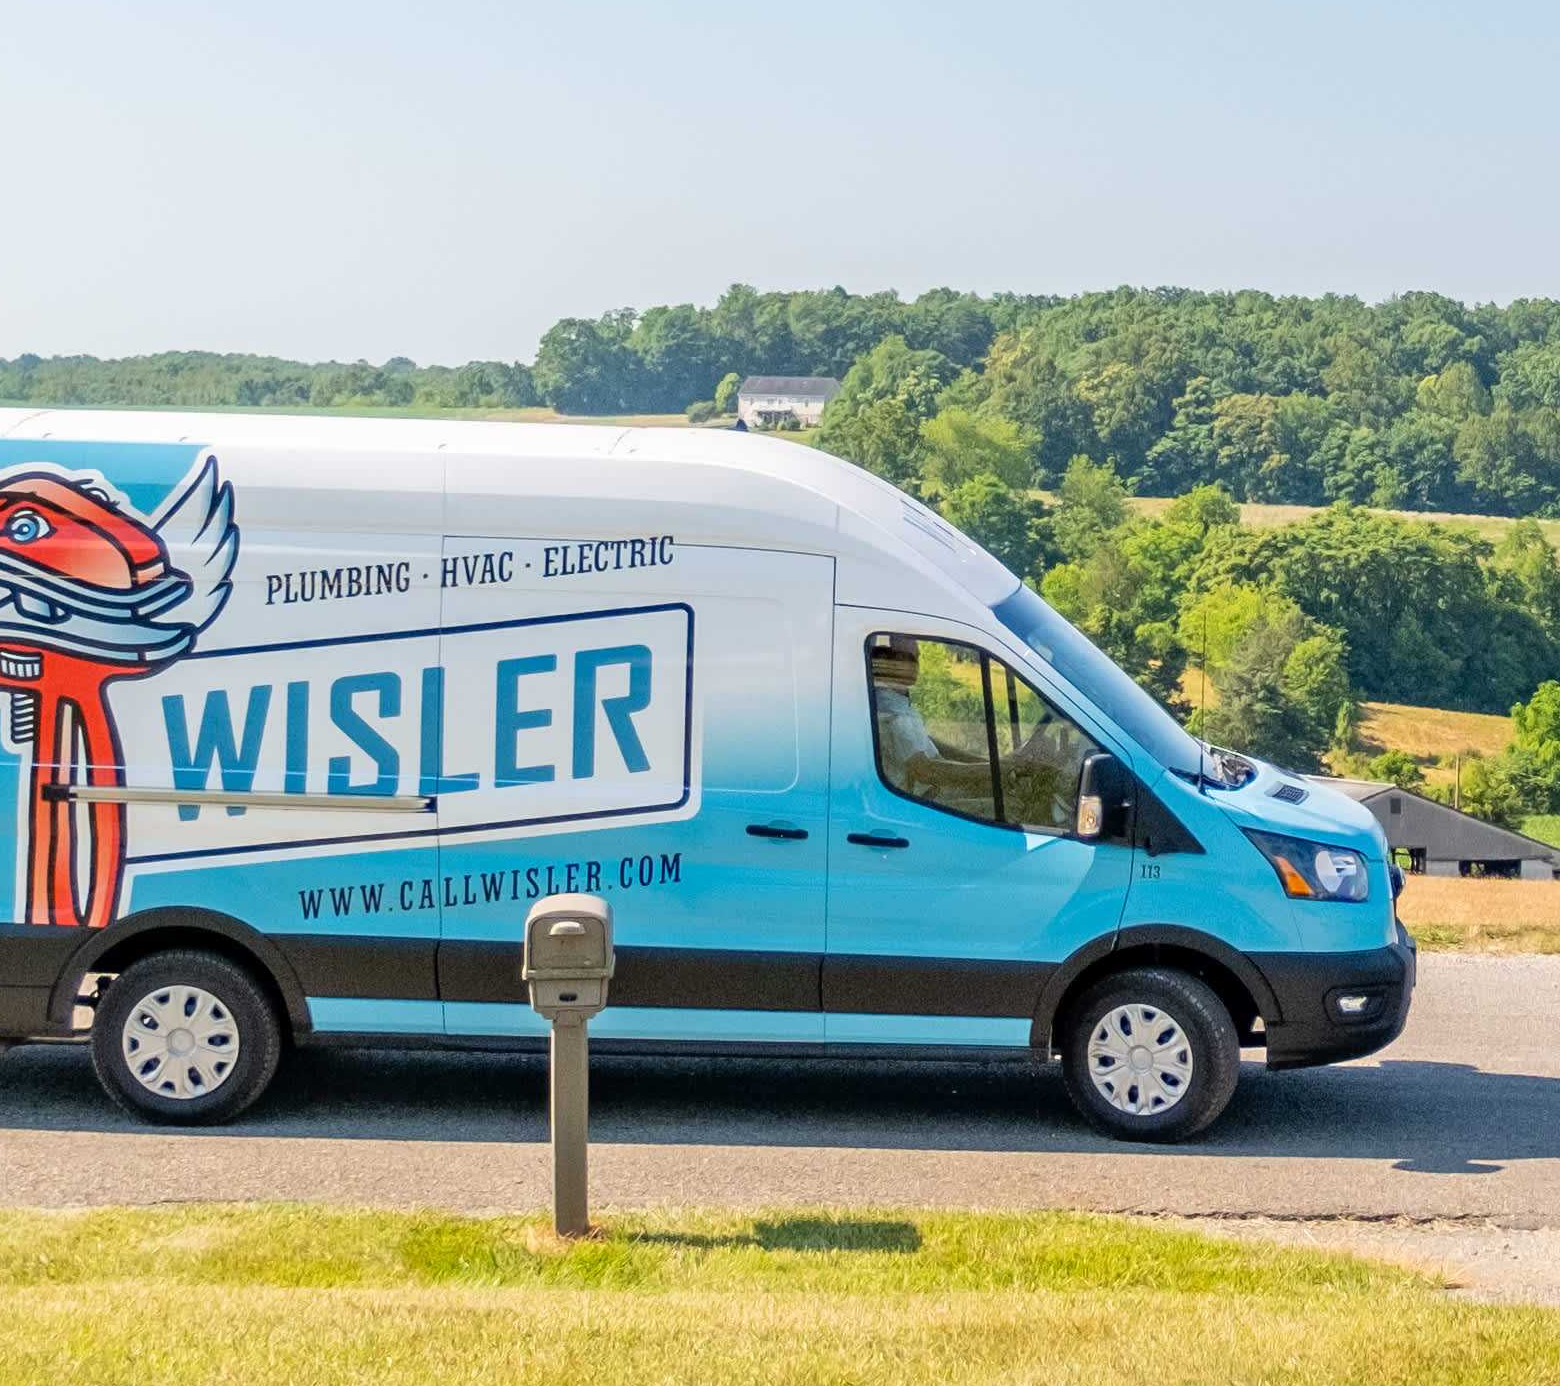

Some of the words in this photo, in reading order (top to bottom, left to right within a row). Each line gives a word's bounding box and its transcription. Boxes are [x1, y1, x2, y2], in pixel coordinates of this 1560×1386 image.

[265, 561, 411, 605] PLUMBING
[440, 551, 514, 588] HVAC
[542, 535, 675, 578] ELECTRIC
[161, 643, 653, 822] WISLER
[298, 852, 683, 920] WWW.CALLWISLER.COM
